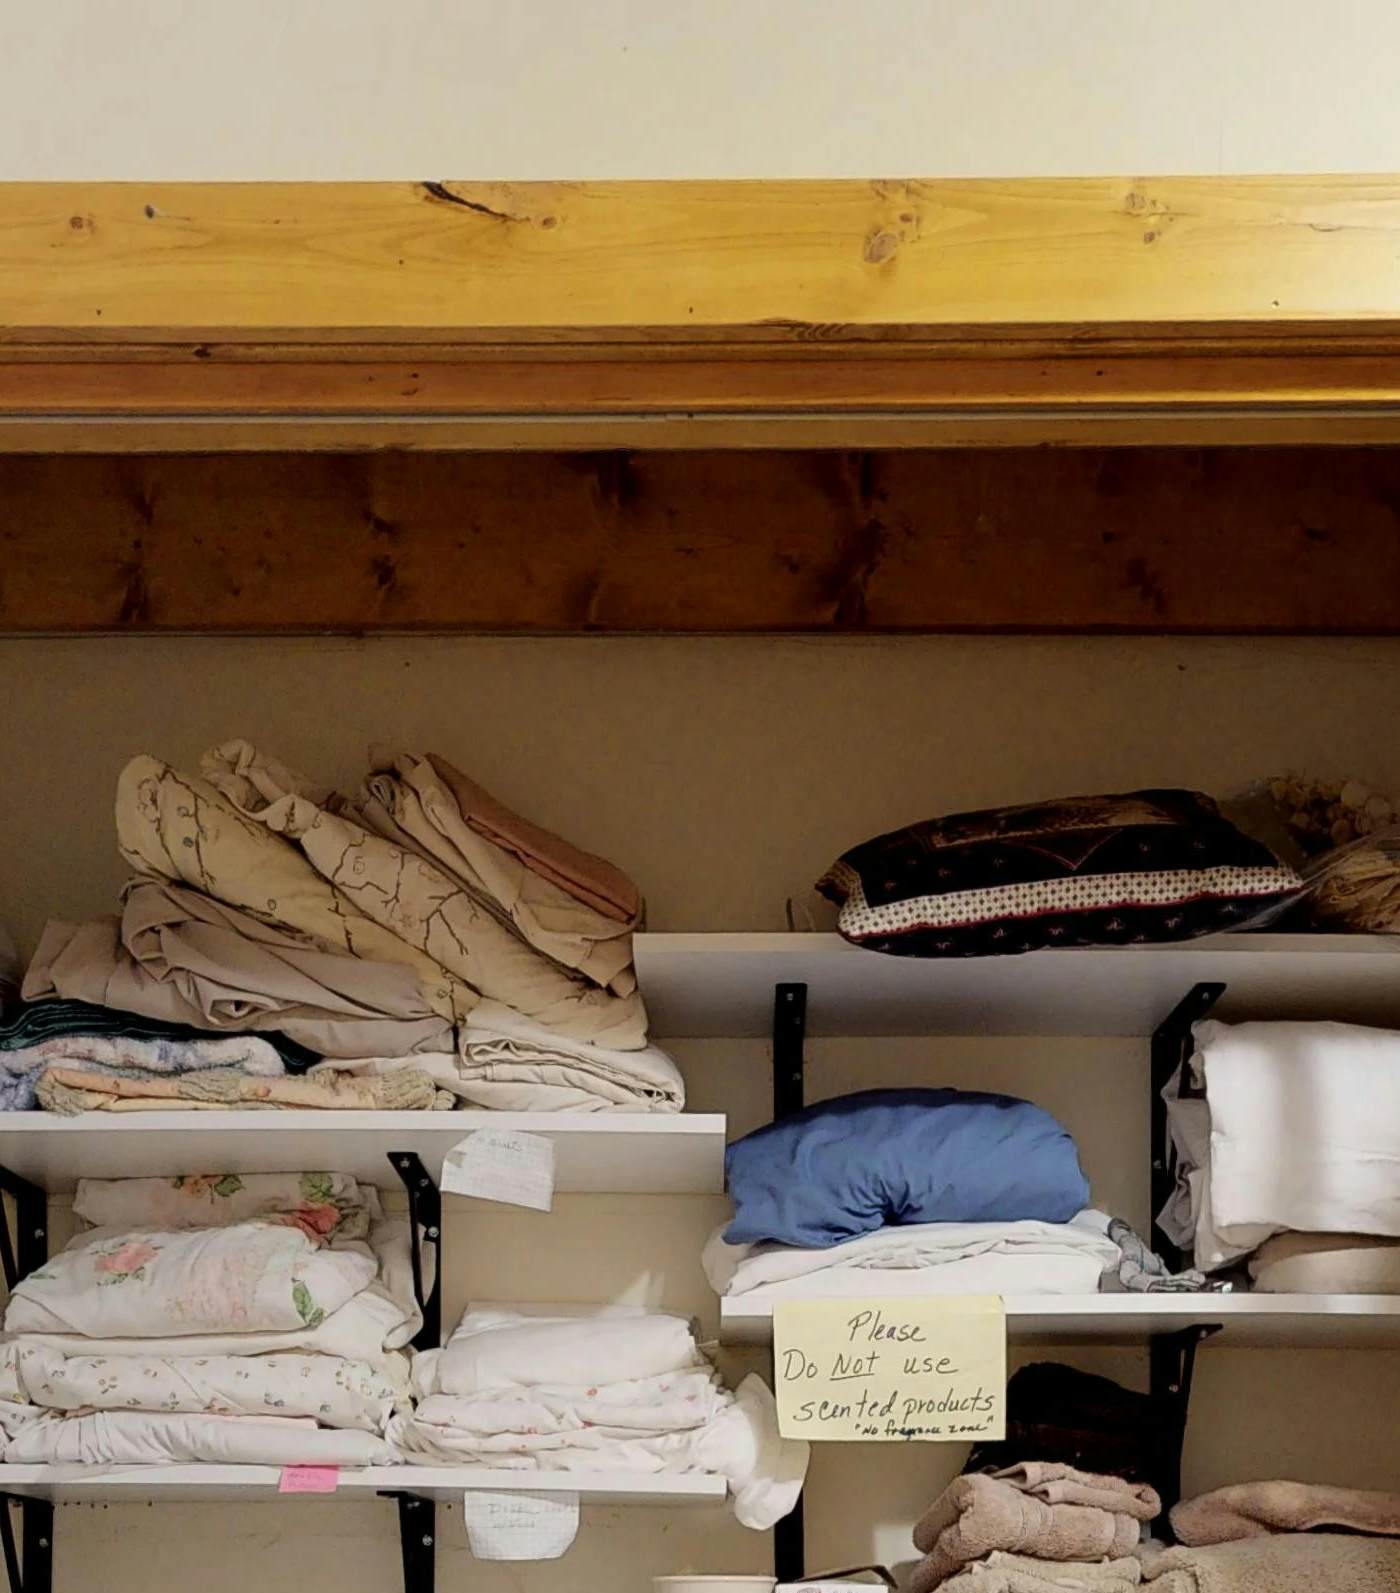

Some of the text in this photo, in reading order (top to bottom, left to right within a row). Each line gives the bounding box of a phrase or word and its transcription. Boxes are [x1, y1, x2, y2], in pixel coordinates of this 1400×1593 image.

[848, 1311, 926, 1341] Please
[783, 1349, 818, 1380] Do
[903, 1355, 959, 1374] use
[793, 1388, 996, 1423] scented products
